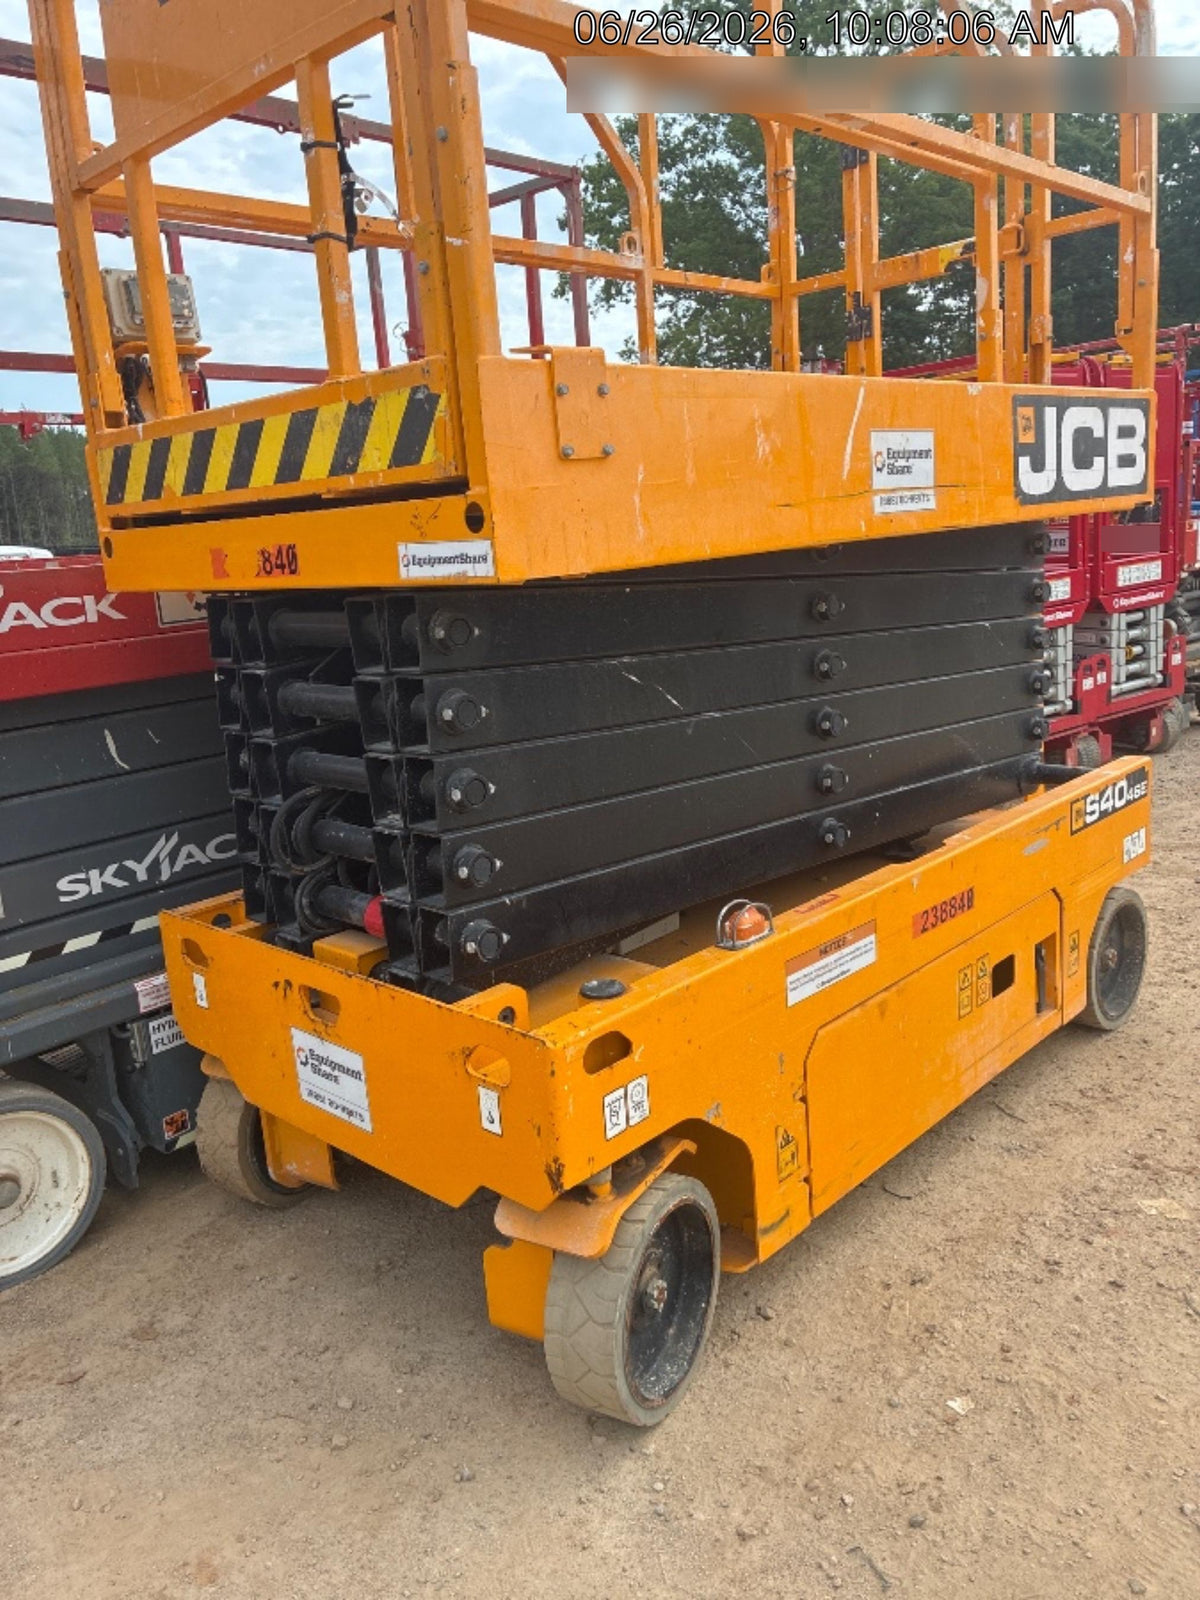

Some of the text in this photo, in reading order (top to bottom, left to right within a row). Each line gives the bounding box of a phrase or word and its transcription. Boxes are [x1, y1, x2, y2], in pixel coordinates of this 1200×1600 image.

[1018, 406, 1146, 495] JCB
[0, 592, 127, 634] ACK
[56, 831, 237, 902] SKYJAC
[920, 887, 975, 934] 238840
[152, 1019, 178, 1034] HYD
